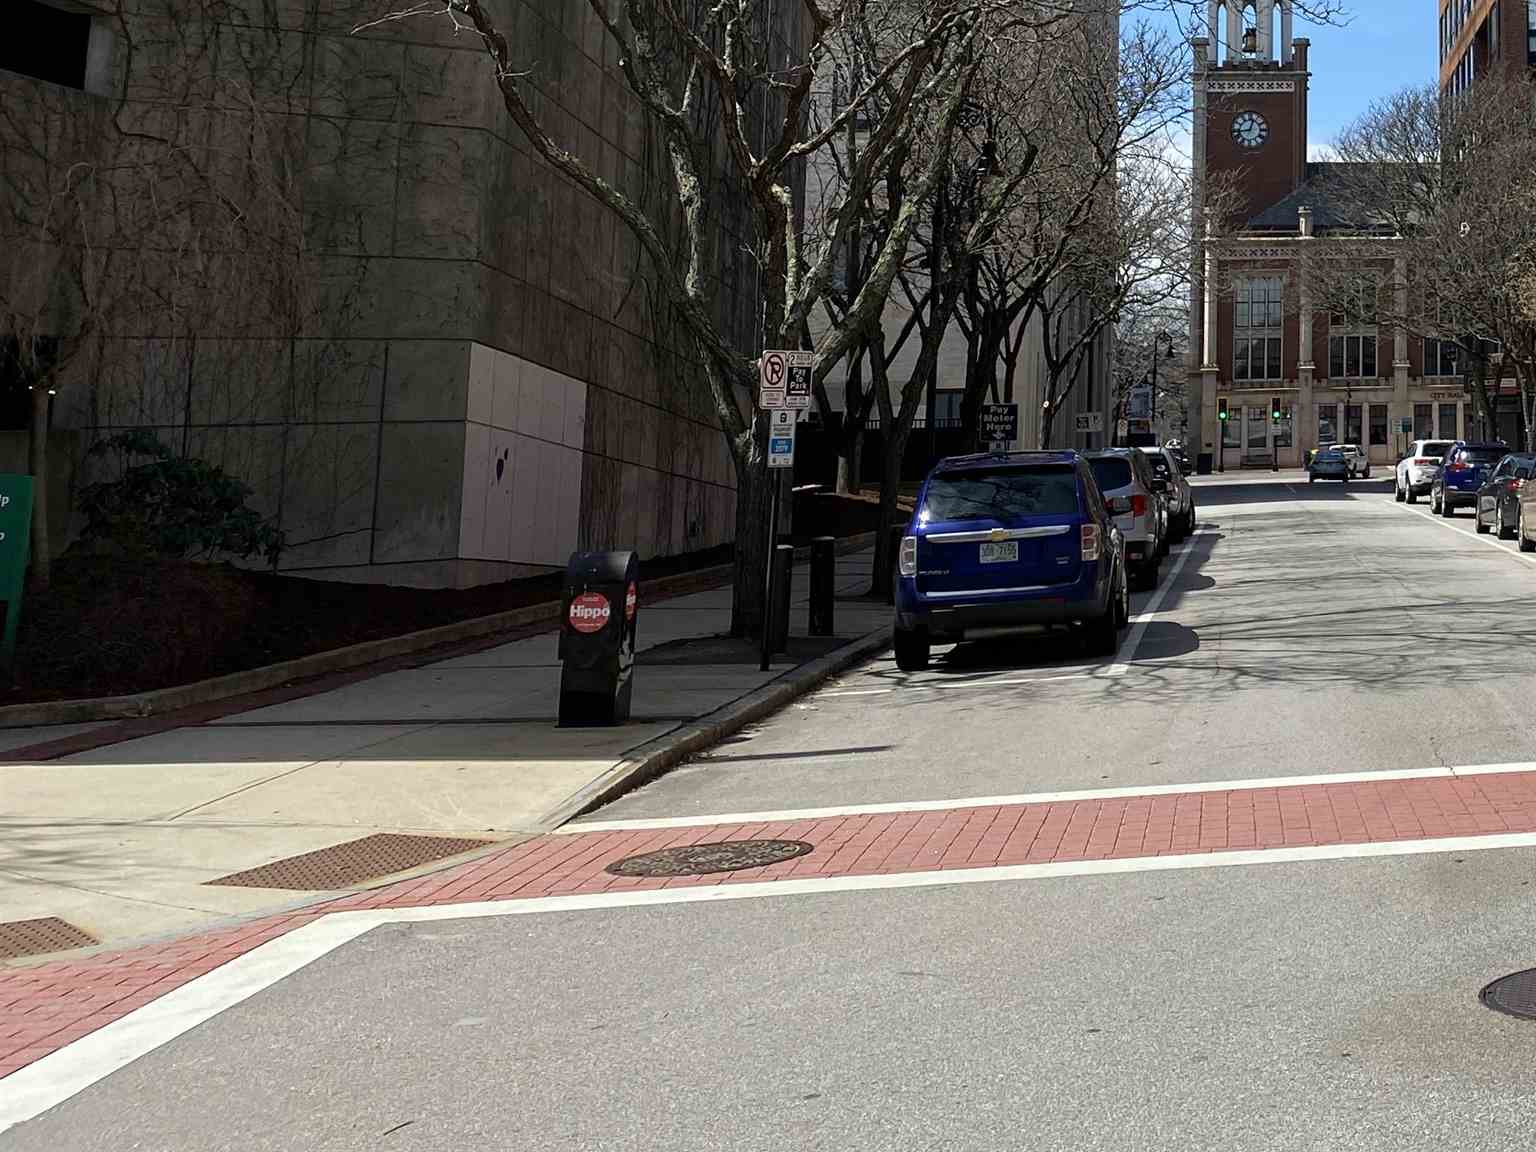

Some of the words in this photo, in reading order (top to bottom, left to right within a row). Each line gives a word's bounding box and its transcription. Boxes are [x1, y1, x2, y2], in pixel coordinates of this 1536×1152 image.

[790, 381, 807, 389] Park
[990, 406, 1009, 415] Pay
[570, 604, 610, 619] Hippo
